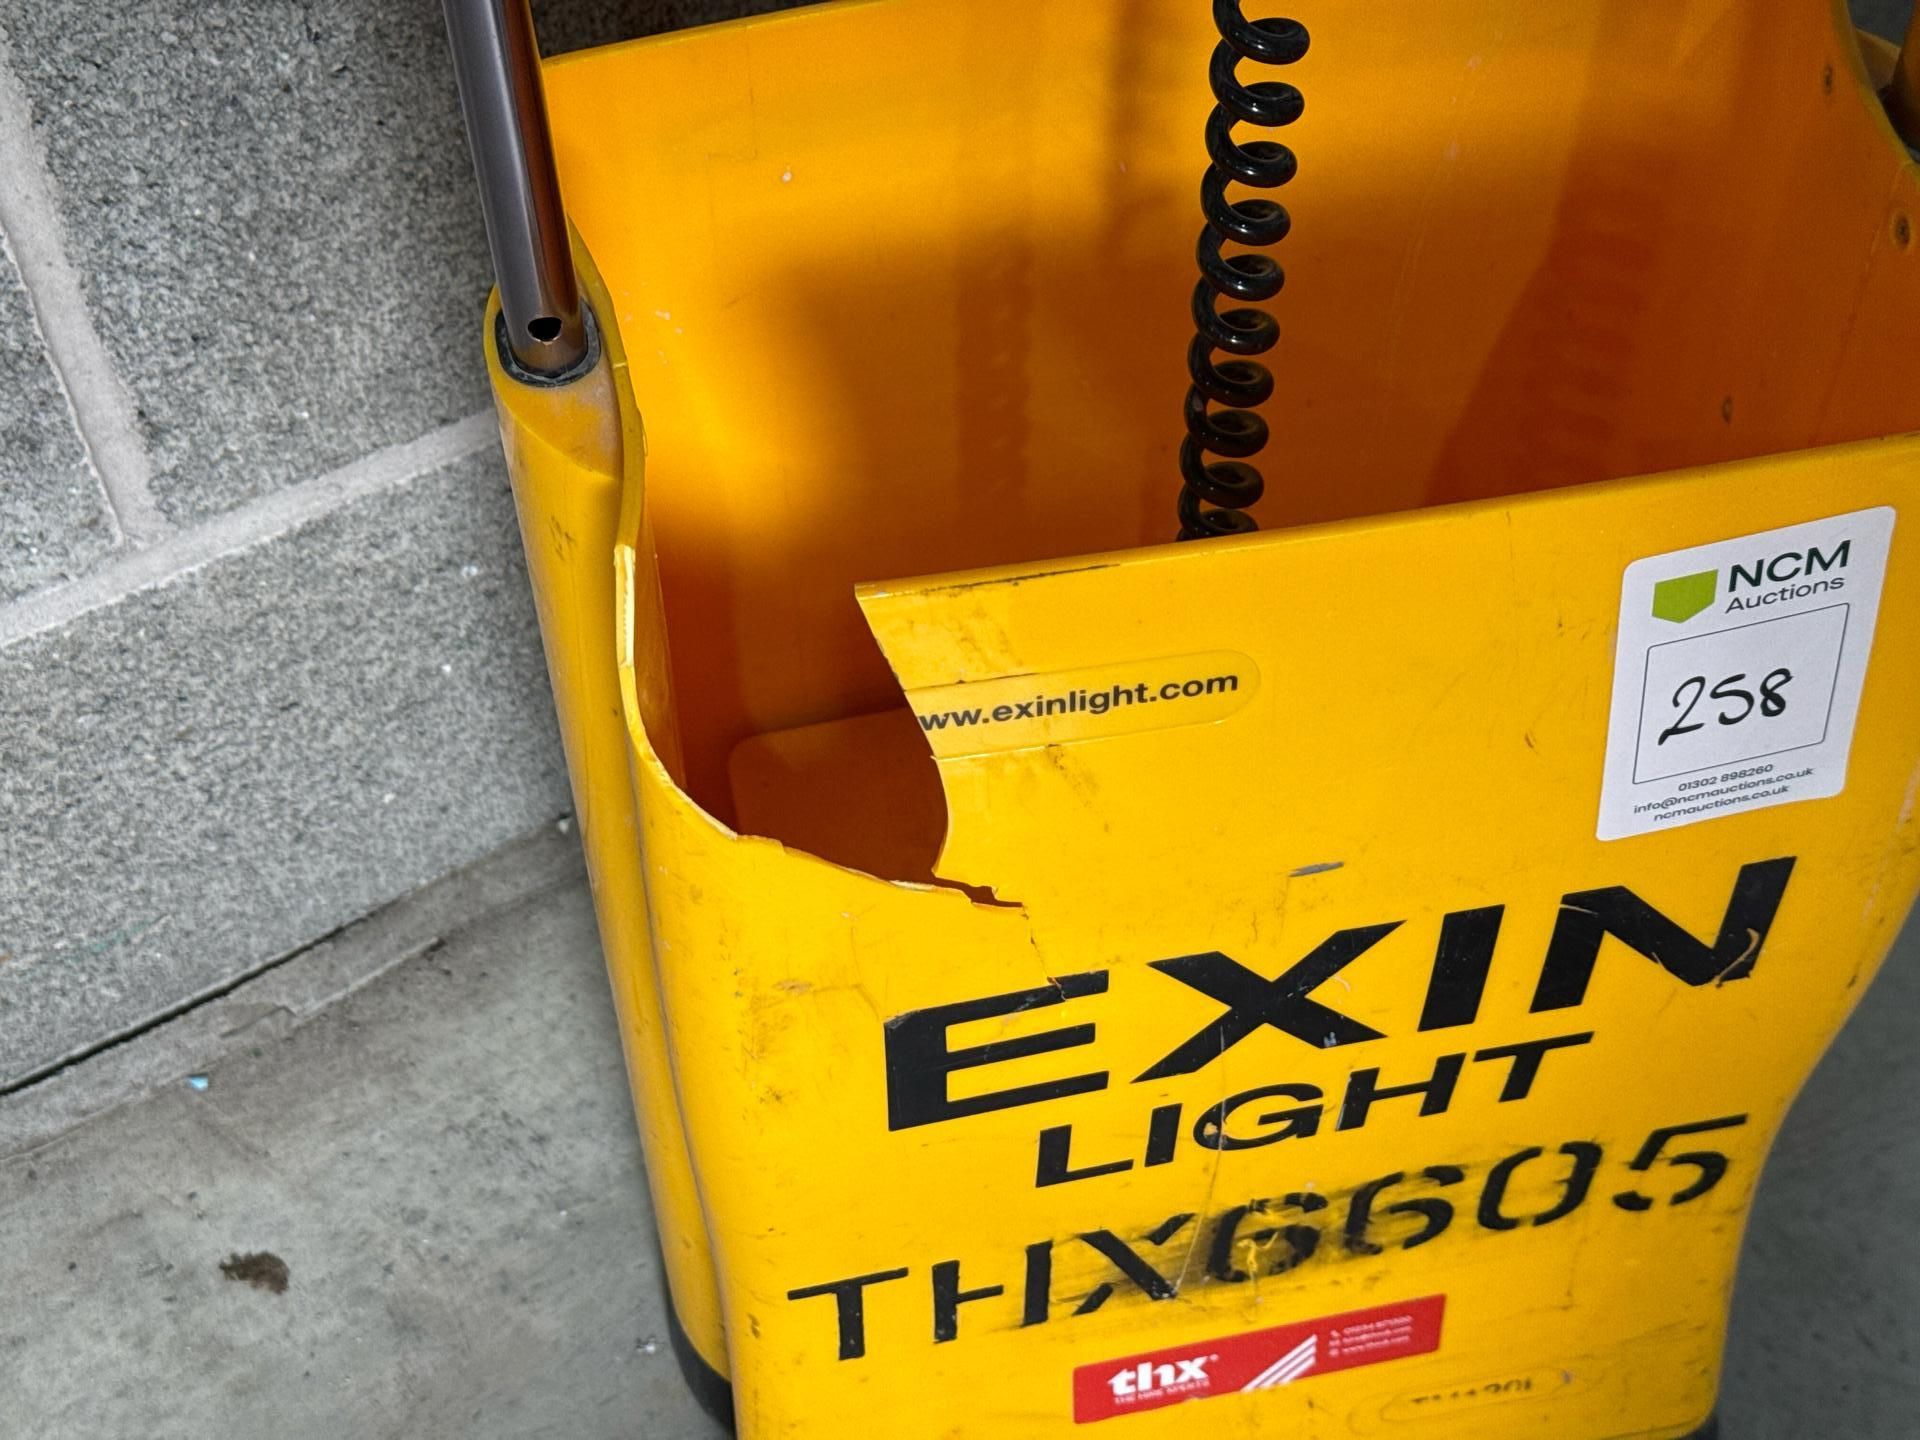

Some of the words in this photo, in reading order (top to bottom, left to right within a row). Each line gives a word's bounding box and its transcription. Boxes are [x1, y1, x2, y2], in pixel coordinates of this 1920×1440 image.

[1727, 539, 1852, 593] NCM
[1725, 575, 1846, 615] Auctions
[1657, 667, 1794, 746] 258
[1633, 767, 1815, 814] info@ncmauctions.co.uk
[1653, 784, 1790, 822] ncmauctions.co.uk
[1677, 776, 1718, 792] 01302
[1720, 764, 1774, 783] 898260
[884, 856, 1797, 1131] EXIN
[1034, 1031, 1594, 1189] LIGHT
[787, 1114, 1748, 1361] THX6605
